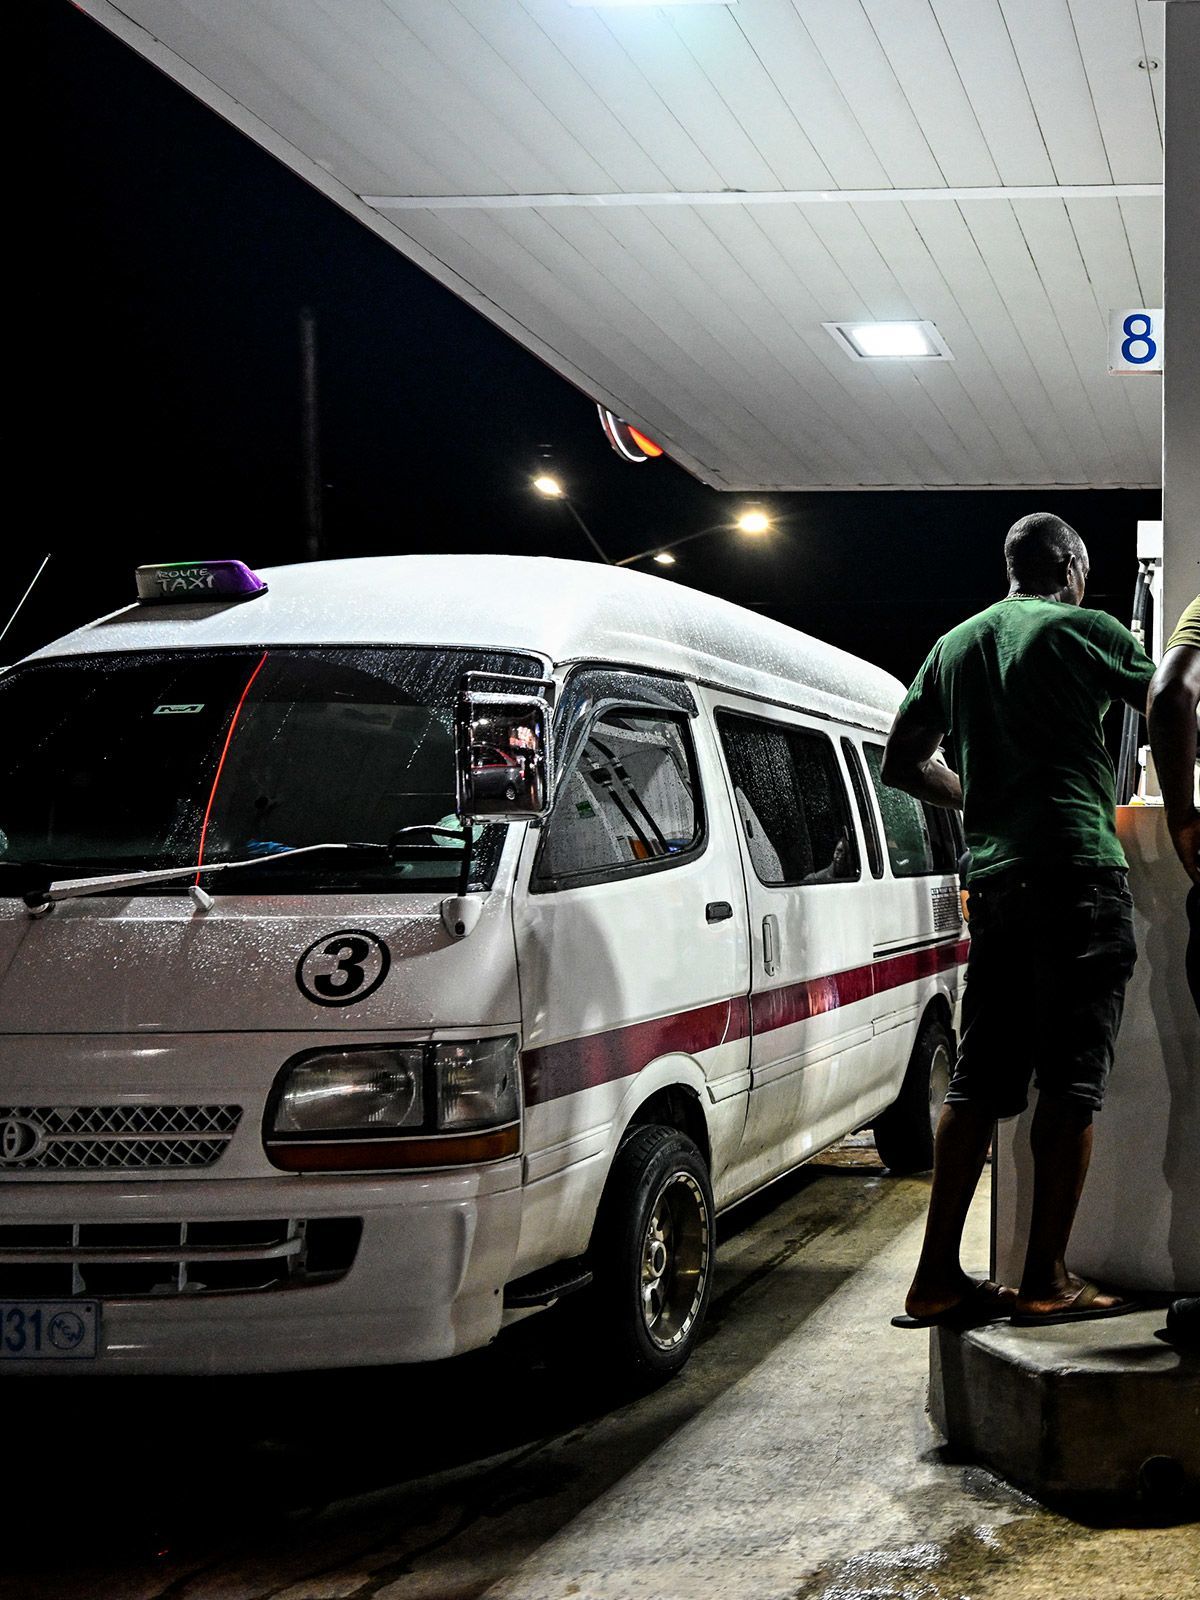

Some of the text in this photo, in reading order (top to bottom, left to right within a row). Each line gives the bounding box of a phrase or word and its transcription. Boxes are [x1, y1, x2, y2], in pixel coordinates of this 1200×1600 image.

[1121, 313, 1157, 365] 8
[157, 568, 208, 578] ROUTE
[157, 573, 215, 592] TAXI
[314, 937, 370, 998] 3
[0, 1309, 42, 1352] 31
